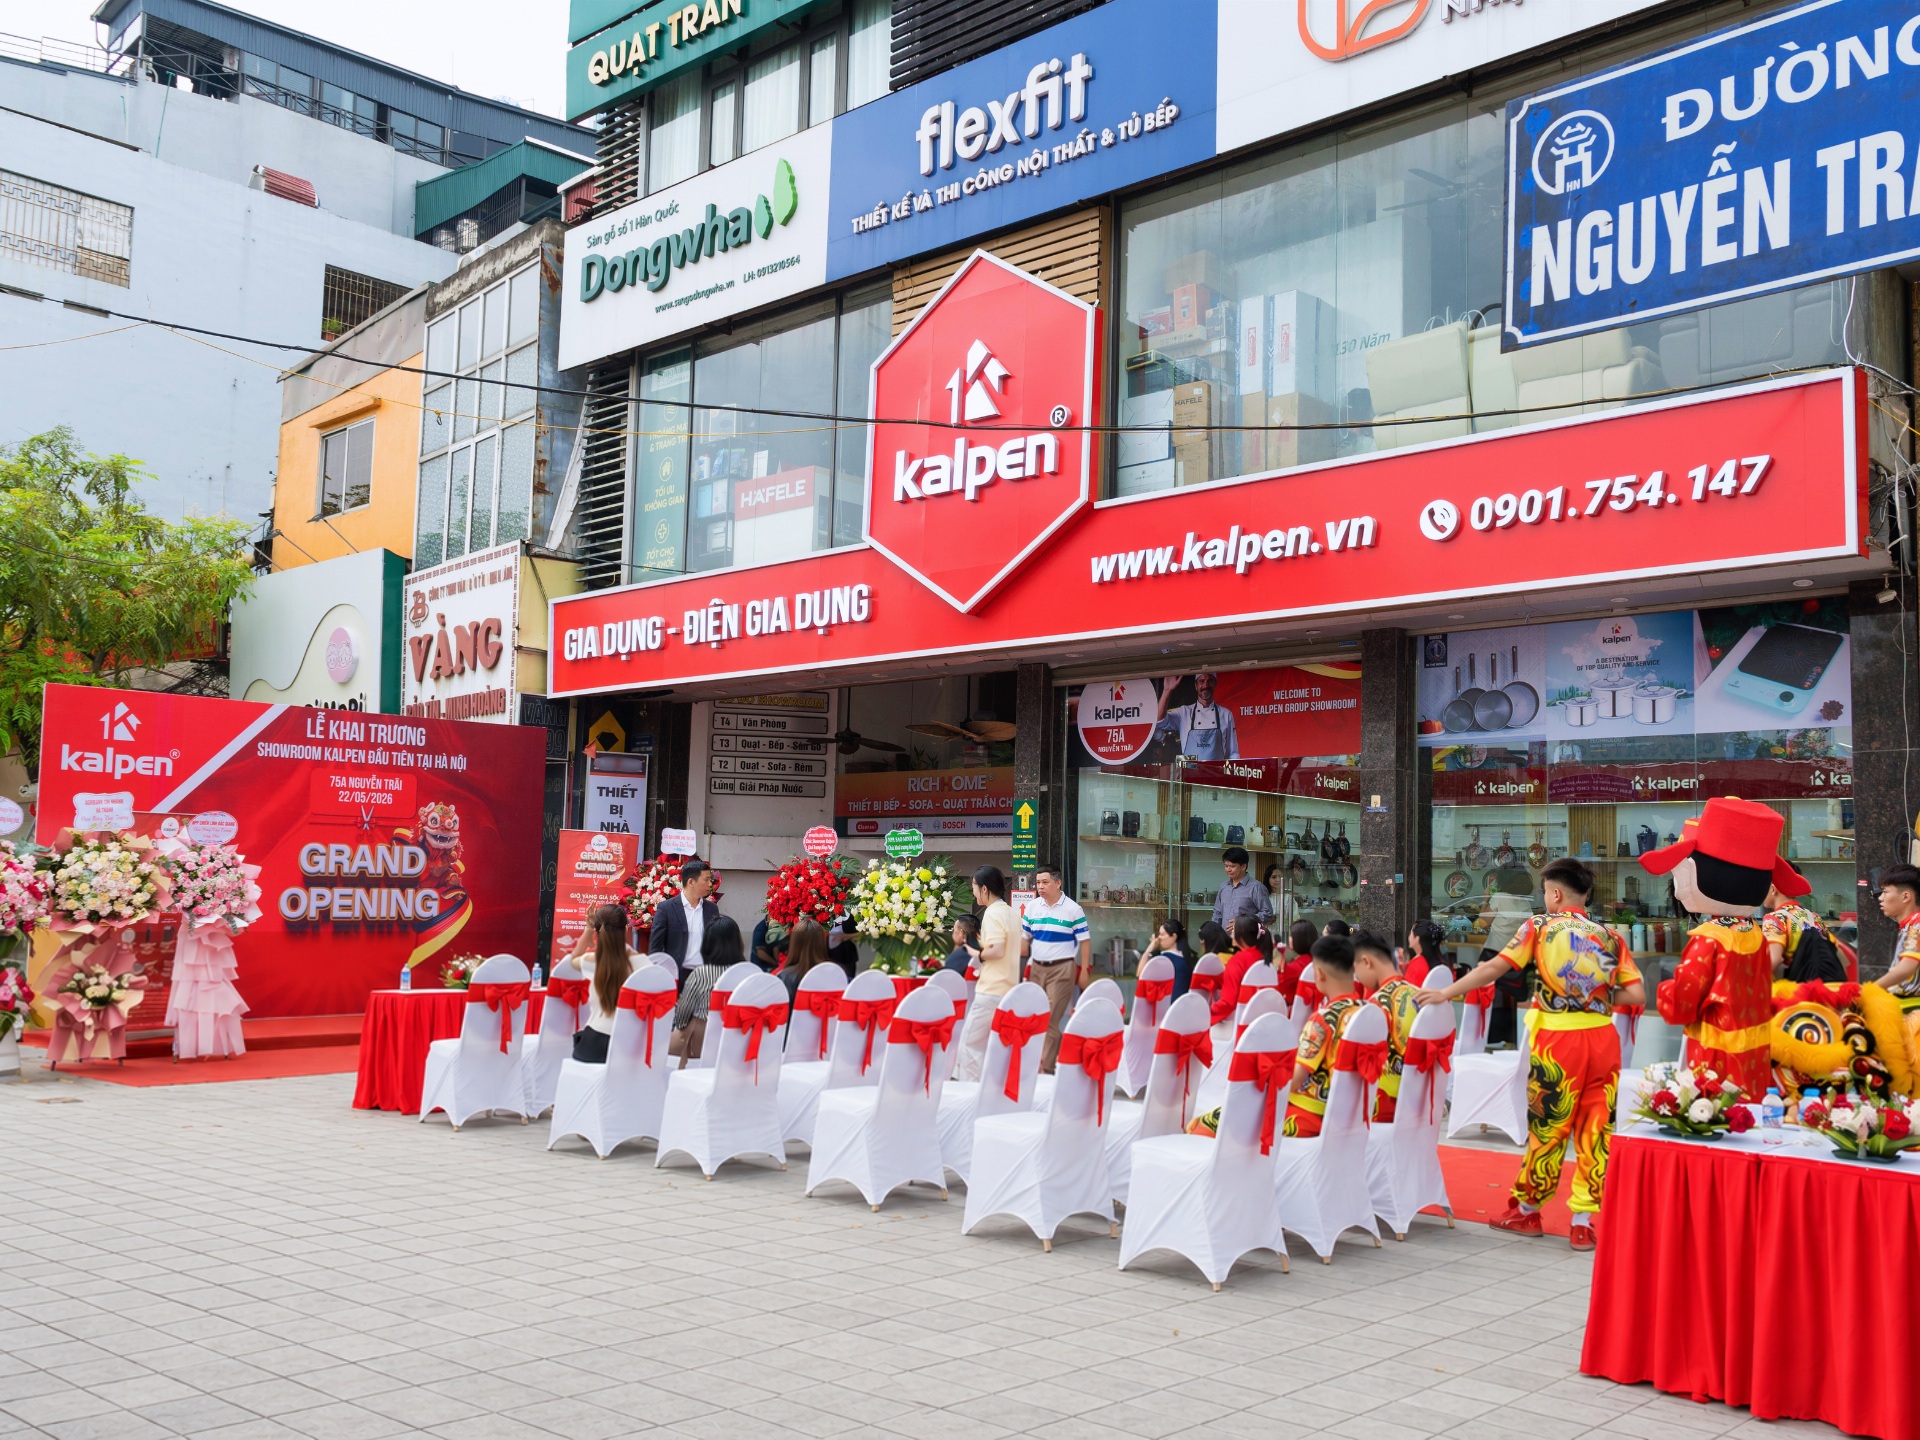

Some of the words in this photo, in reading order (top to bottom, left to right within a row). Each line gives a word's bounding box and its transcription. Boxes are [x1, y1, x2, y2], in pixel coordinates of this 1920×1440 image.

[588, 21, 661, 86] QUẠT
[916, 52, 1093, 176] flexfit
[851, 200, 890, 235] THIẾT
[891, 190, 914, 221] KẾ
[913, 188, 934, 213] VÀ
[936, 181, 961, 206] THI
[962, 163, 1015, 196] CÔNG
[1017, 148, 1050, 178] NỘI
[1052, 127, 1098, 164] THẤT
[1101, 127, 1115, 148] &
[1117, 111, 1142, 142] TỦ
[1144, 96, 1180, 133] BẾP
[1566, 178, 1581, 192] HN
[586, 234, 603, 248] Sàn
[604, 224, 616, 246] gỗ
[617, 219, 627, 237] số
[629, 219, 634, 232] 1
[635, 214, 652, 230] Hàn
[654, 199, 680, 223] Quốc
[1530, 140, 1791, 308] NGUYỄN
[1816, 130, 1920, 237] TR
[580, 203, 752, 303] Dongwha
[655, 279, 735, 314] www.sangodongwha.vn
[743, 269, 756, 284] LH:
[756, 254, 801, 278] 0913210564
[1360, 332, 1391, 351] Năm
[676, 421, 688, 432] MÁ
[894, 432, 1060, 503] kalpen
[740, 479, 807, 509] HÄFELE
[644, 499, 668, 513] KHÔNG
[668, 494, 685, 506] GIAN
[646, 547, 659, 560] TỐT
[659, 546, 675, 558] CHO
[1090, 515, 1378, 584] www.kalpen.vn
[564, 626, 601, 662] GIA
[603, 615, 666, 661] DỤNG
[683, 598, 742, 649] ĐIỆN
[745, 596, 791, 637] GIA
[795, 583, 873, 636] DỤNG
[409, 612, 504, 683] VÀNG
[1602, 635, 1631, 645] kalpen
[1597, 662, 1621, 670] QUALITY
[1636, 659, 1660, 667] SERVICE
[1601, 655, 1639, 664] DESTINATION
[758, 695, 825, 709] SHOWROOM
[1273, 687, 1310, 700] WELCOME
[1311, 687, 1321, 697] TO
[425, 694, 441, 720] TÍN
[445, 694, 472, 722] MINH
[472, 684, 507, 718] HOÀNG
[1240, 706, 1254, 716] THE
[1255, 703, 1283, 715] KALPEN
[1285, 701, 1309, 713] GROUP
[1310, 699, 1357, 711] SHOWROOM!
[1094, 704, 1140, 722] kalpen
[306, 712, 326, 739] LỄ
[329, 719, 364, 742] KHAI
[368, 723, 426, 747] TRƯƠNG
[720, 717, 731, 726] T4
[742, 717, 758, 728] Văn
[760, 718, 787, 729] Phòng
[1106, 728, 1125, 743] 75A
[719, 738, 730, 748] T3
[741, 739, 761, 751] Quạt
[768, 738, 785, 750] Bếp
[1098, 743, 1120, 753] NGUYỄN
[60, 743, 173, 780] kalpen
[257, 741, 322, 760] SHOWROOM
[324, 747, 366, 764] KALPEN
[368, 746, 389, 766] ĐẦU
[392, 749, 414, 768] TIÊN
[417, 753, 433, 771] TẠI
[435, 752, 448, 770] HÀ
[450, 754, 467, 773] NỘI
[718, 760, 729, 769] T2
[740, 760, 759, 772] Quạt
[767, 761, 786, 771] Sofa
[794, 762, 813, 772] Rèm
[1233, 763, 1263, 781] kalpen
[329, 775, 348, 788] 75A
[348, 774, 382, 790] NGUYỄN
[383, 777, 403, 791] TRÃI
[597, 783, 639, 798] THIẾT
[739, 781, 756, 792] Giải
[758, 782, 780, 793] Pháp
[781, 783, 804, 794] Nước
[1323, 775, 1349, 791] kalpen
[1489, 781, 1535, 797] kalpen
[1648, 776, 1699, 792] kalpen
[338, 790, 393, 805] 22/05/2026
[848, 797, 872, 812] THIẾT
[873, 801, 882, 814] BỊ
[883, 796, 900, 811] BẾP
[908, 798, 934, 810] SOFA
[942, 798, 968, 812] QUẠT
[969, 794, 997, 809] TRẦN
[609, 804, 624, 818] BỊ
[600, 819, 631, 834] NHÀ
[942, 821, 966, 829] BOSCH
[976, 820, 1009, 829] Panasonic
[298, 842, 427, 879] GRAND
[579, 851, 614, 863] GRAND
[575, 861, 617, 874] OPENING
[278, 886, 440, 922] OPENING
